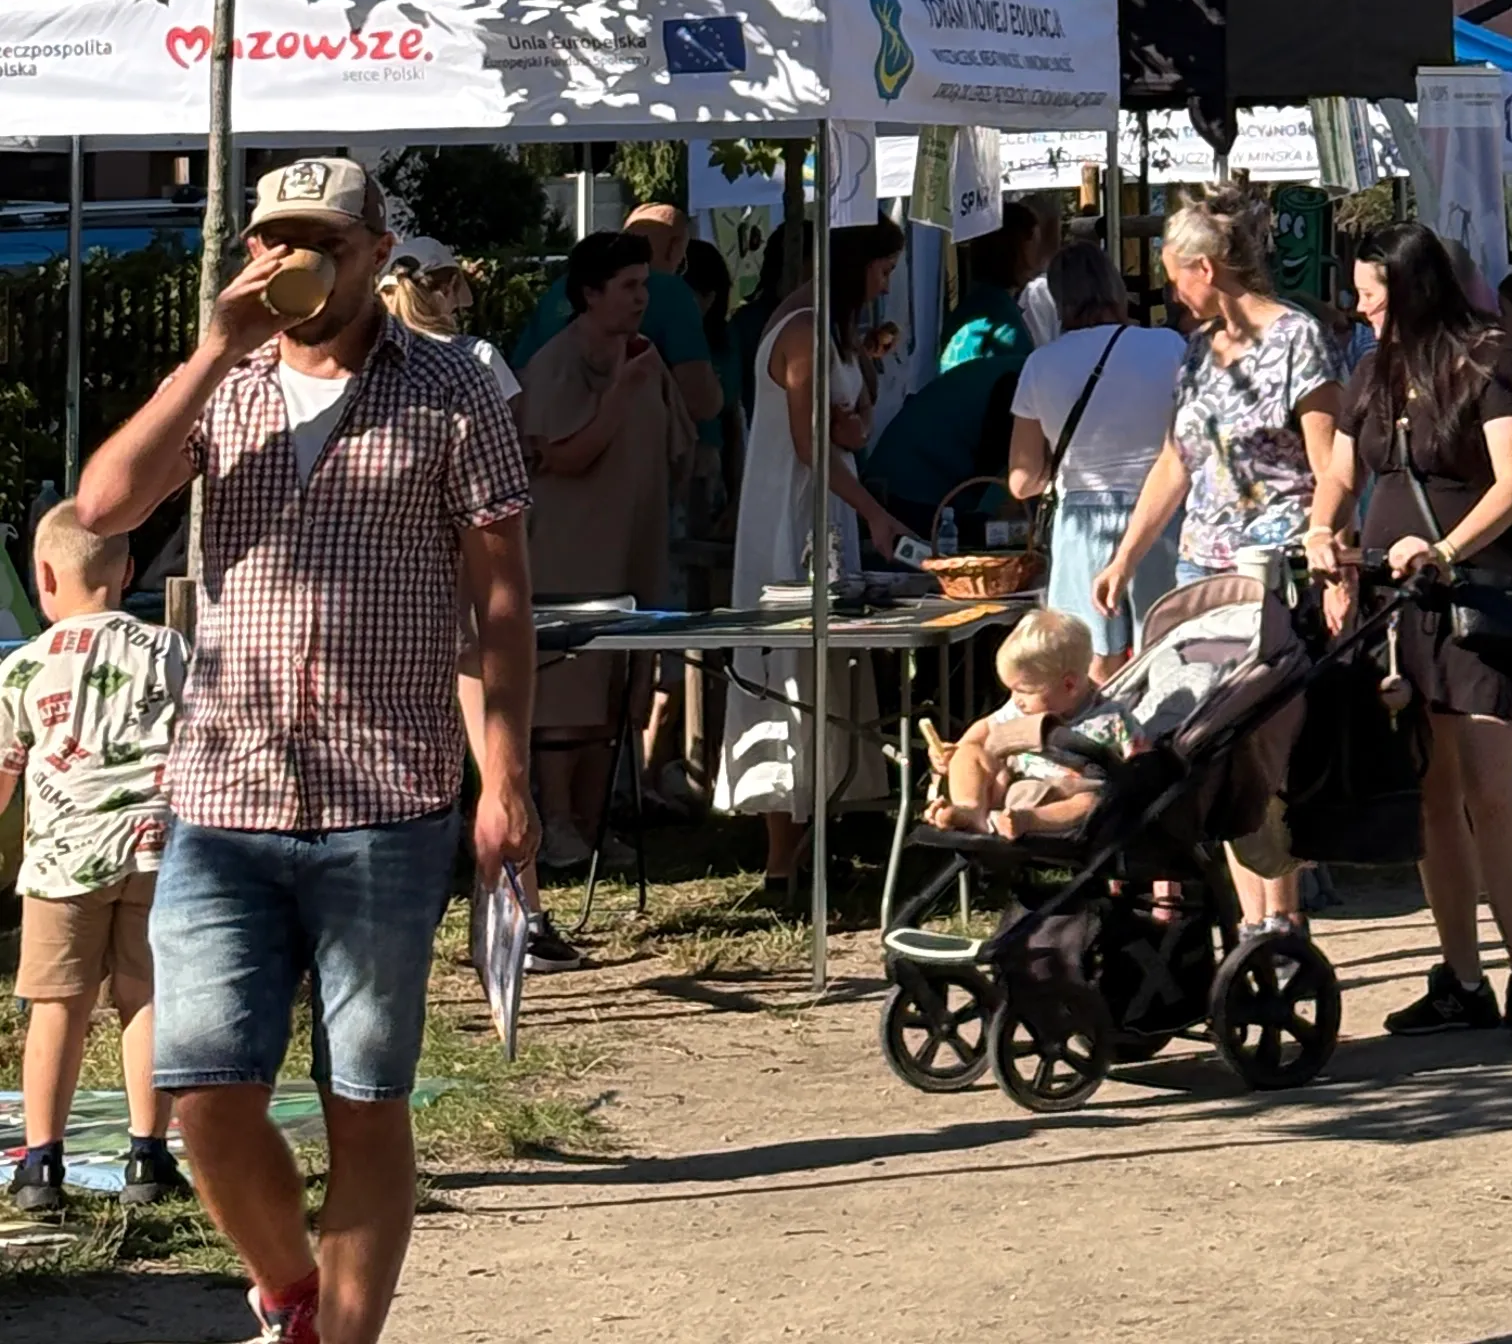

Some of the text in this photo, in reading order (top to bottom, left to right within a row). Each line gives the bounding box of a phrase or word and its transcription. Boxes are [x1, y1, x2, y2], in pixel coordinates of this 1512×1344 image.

[508, 35, 546, 51] Unia
[342, 66, 425, 82] serce Polski
